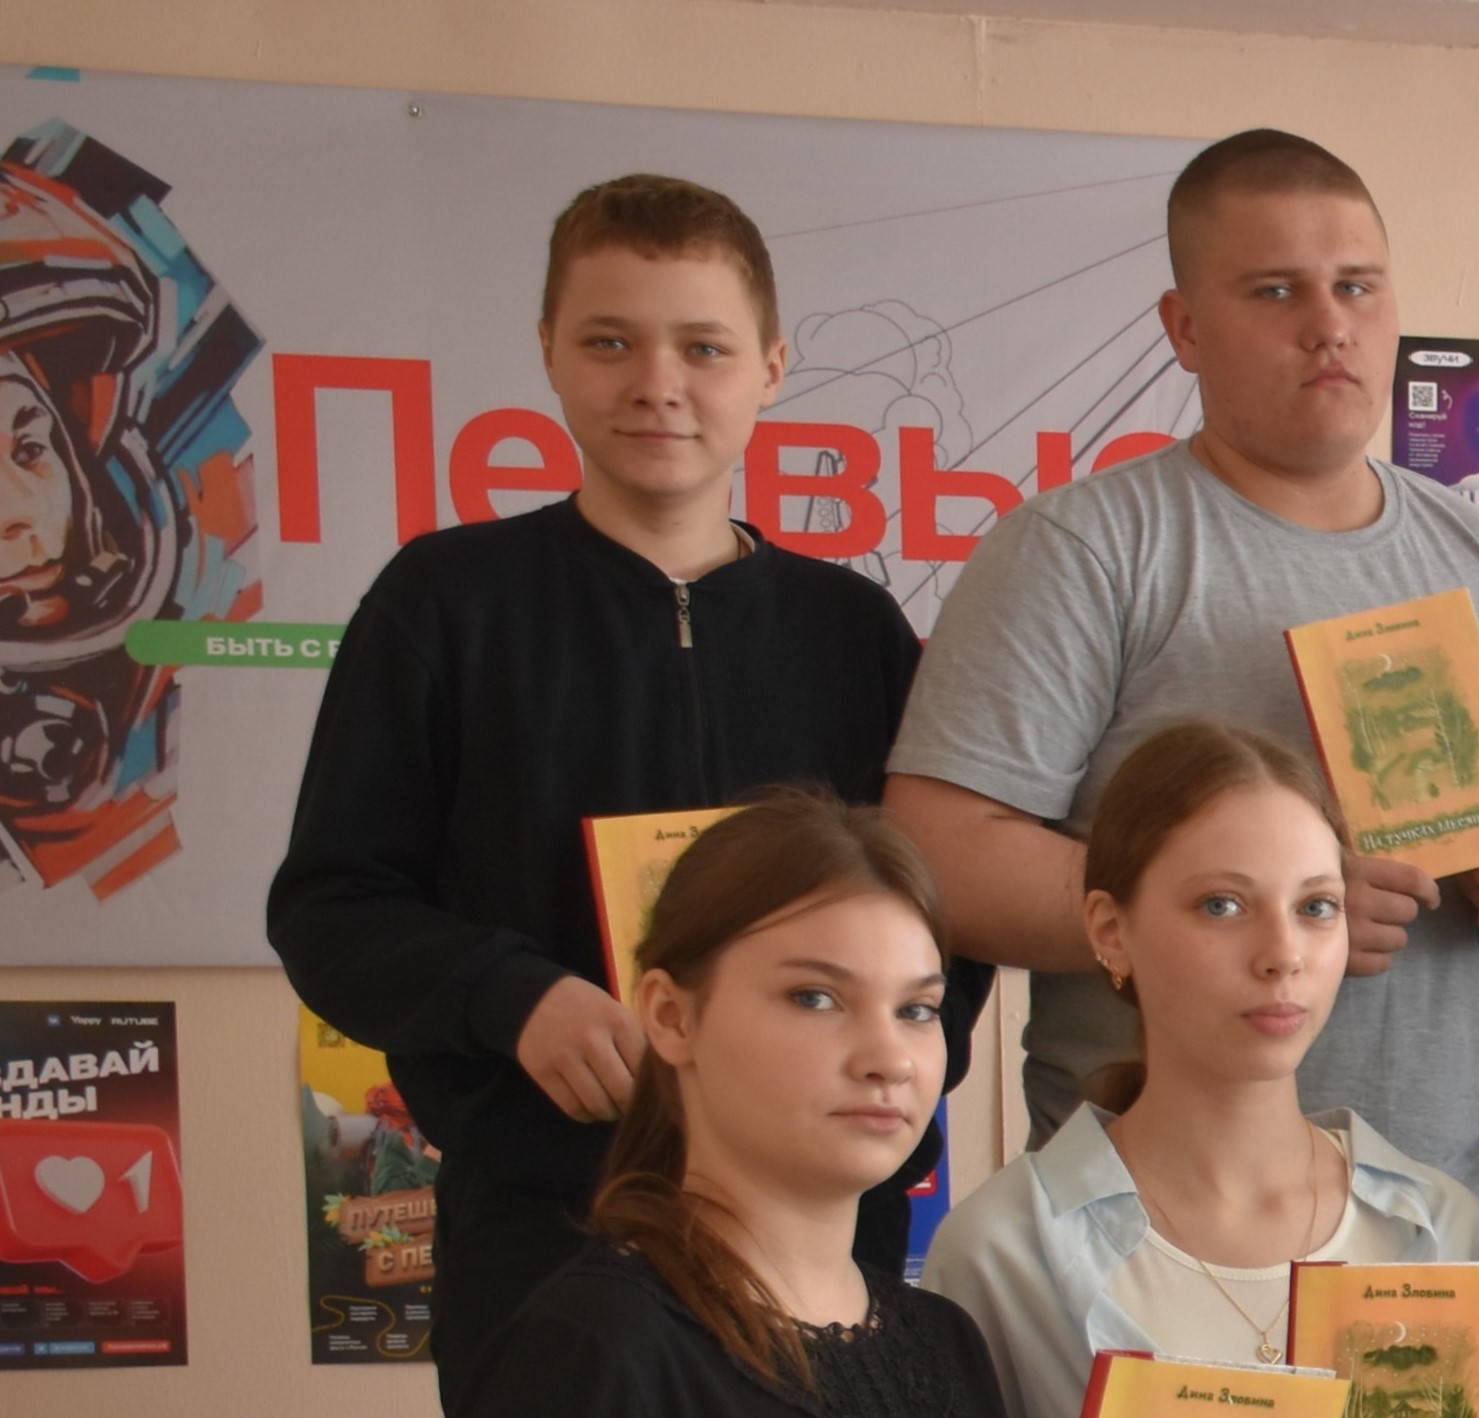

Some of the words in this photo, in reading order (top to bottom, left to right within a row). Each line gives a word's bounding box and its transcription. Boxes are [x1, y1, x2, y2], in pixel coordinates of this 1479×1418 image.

[272, 353, 1178, 563] Певы
[206, 636, 293, 656] БЫТЬ
[300, 639, 321, 657] С
[0, 1040, 160, 1092] ДАВАЙ
[1363, 1284, 1398, 1299] Дина
